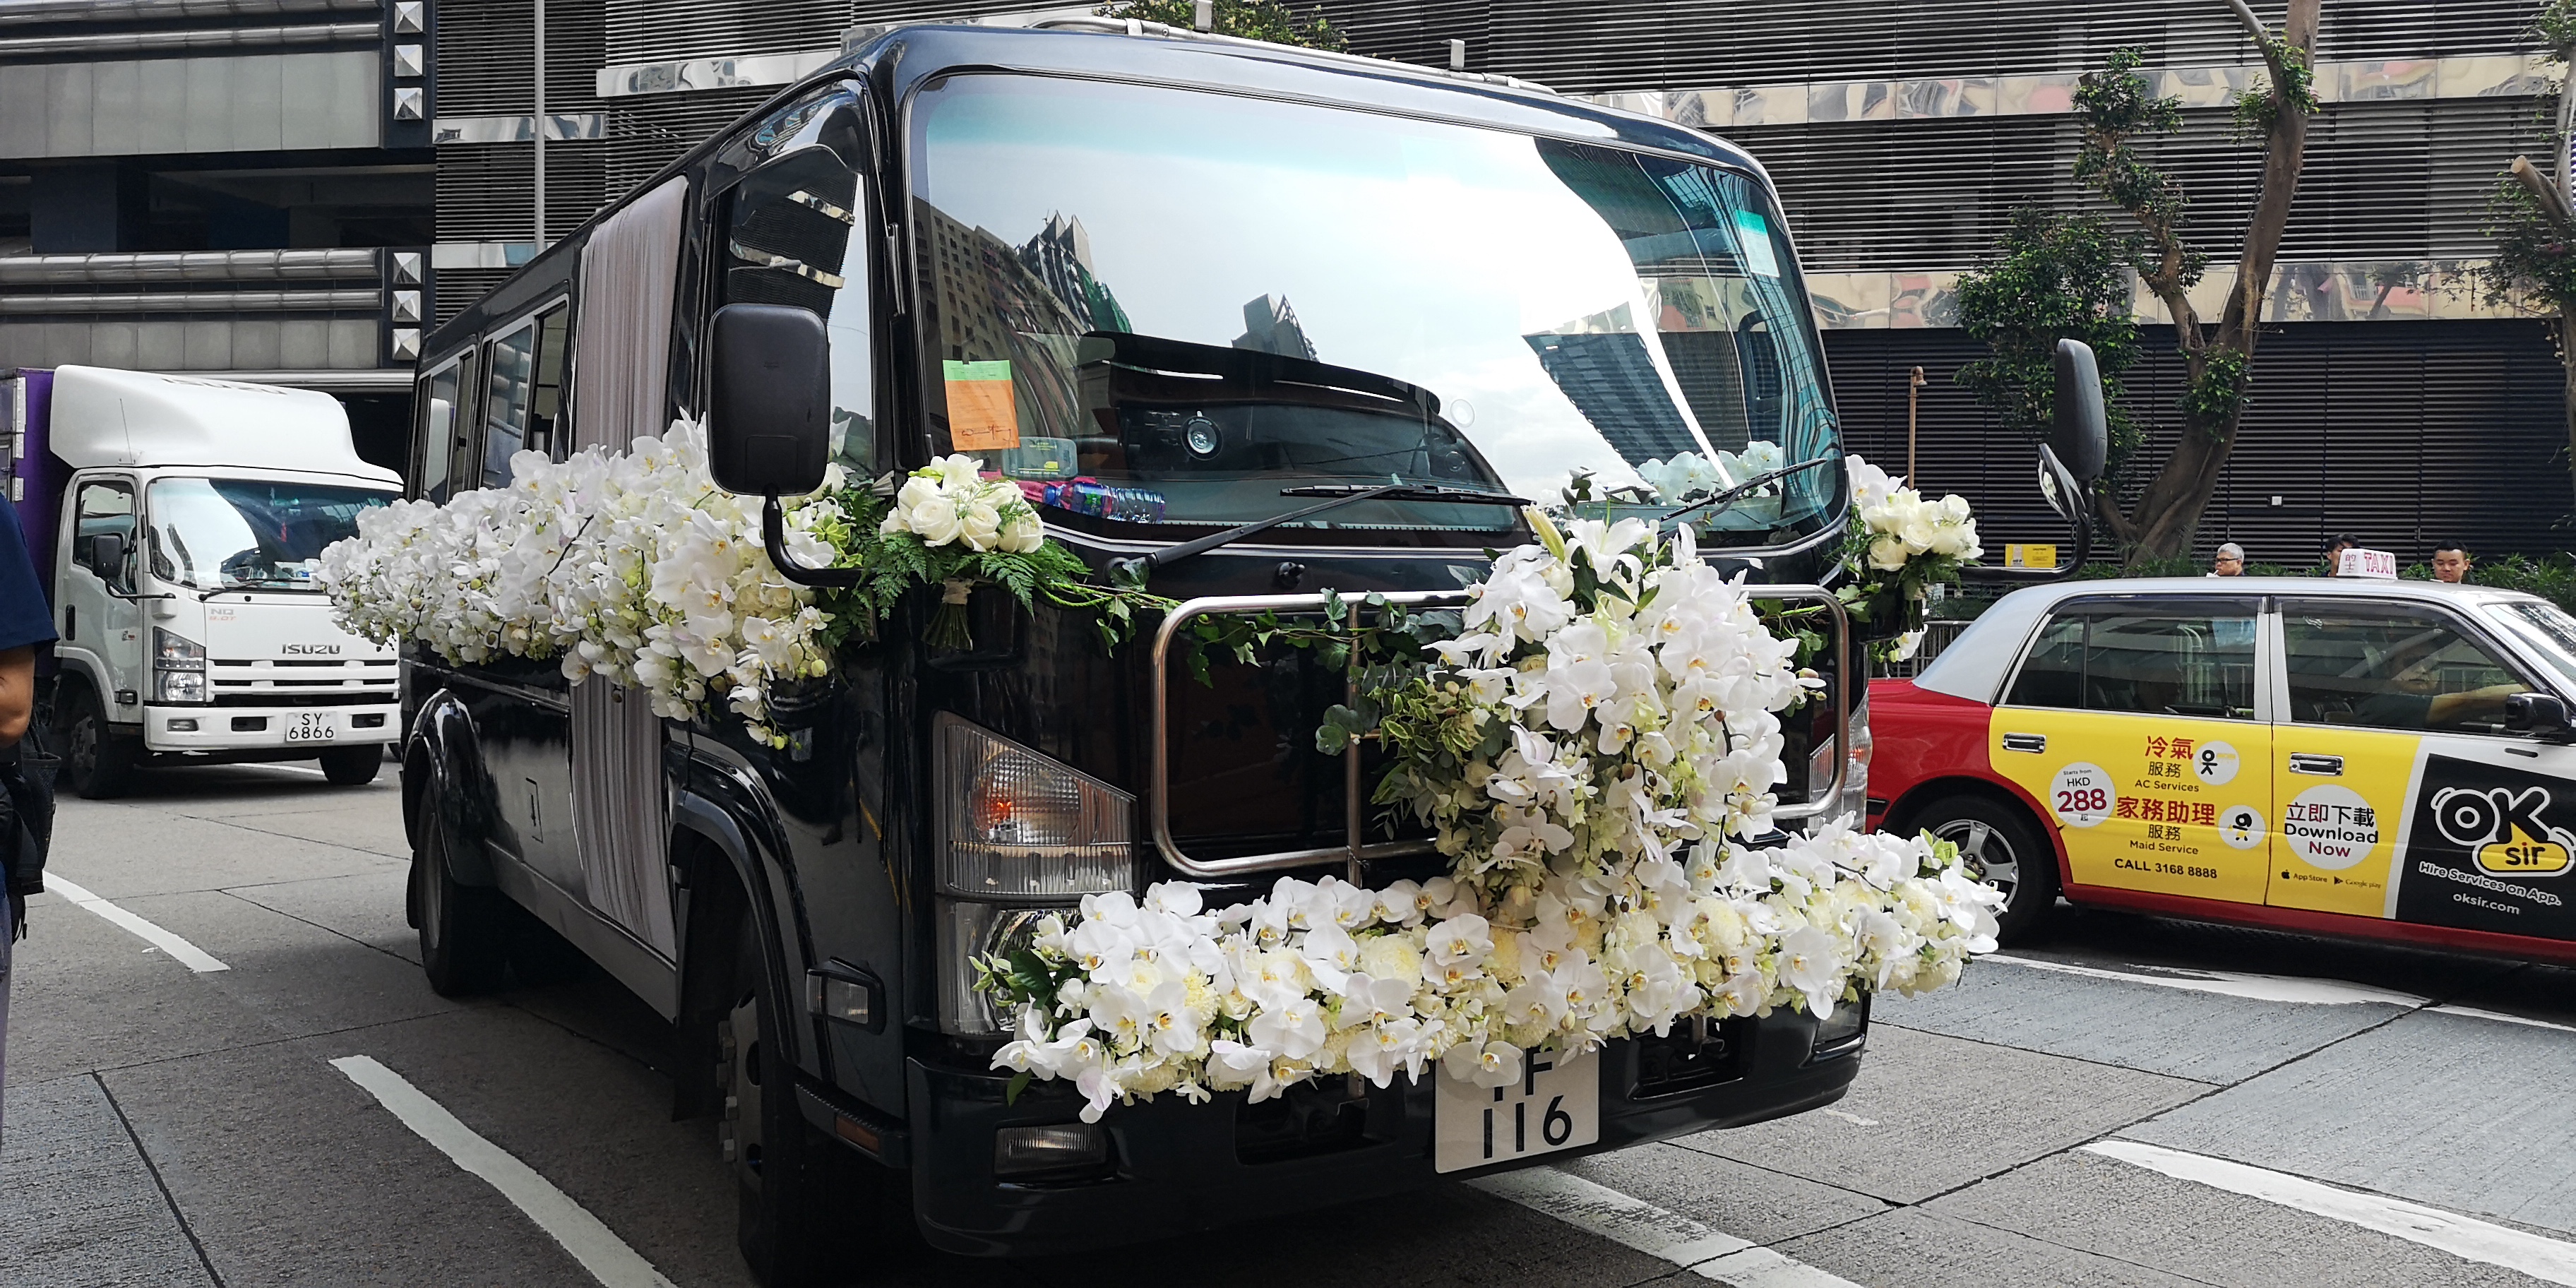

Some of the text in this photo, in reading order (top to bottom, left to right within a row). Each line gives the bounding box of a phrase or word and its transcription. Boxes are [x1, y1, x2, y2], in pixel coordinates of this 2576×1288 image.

[2364, 551, 2393, 574] TAXI
[282, 644, 340, 655] ISUZU
[302, 712, 323, 726] SY
[289, 726, 334, 739] 6866
[2145, 735, 2195, 761] 冷氣
[2147, 761, 2181, 778] 服務
[2067, 777, 2090, 787] HKD
[2135, 779, 2199, 792] AC Services
[2057, 788, 2107, 812] 288
[2116, 796, 2215, 825] 家務助理
[2286, 801, 2375, 828] 立即下載
[2435, 786, 2551, 846] OK
[2147, 824, 2181, 841] 服務
[2284, 823, 2378, 844] Download
[2130, 840, 2199, 855] Maid Service
[2309, 841, 2351, 857] Now
[2505, 841, 2546, 866] sir
[2114, 858, 2217, 878] CALL 3168 8888
[2293, 873, 2328, 883] App Store
[2345, 878, 2368, 888] Google
[2419, 861, 2563, 907] Hire Services on App.
[2452, 893, 2520, 915] oksir.com
[1493, 1046, 1553, 1102] F
[1484, 1095, 1573, 1159] 116
